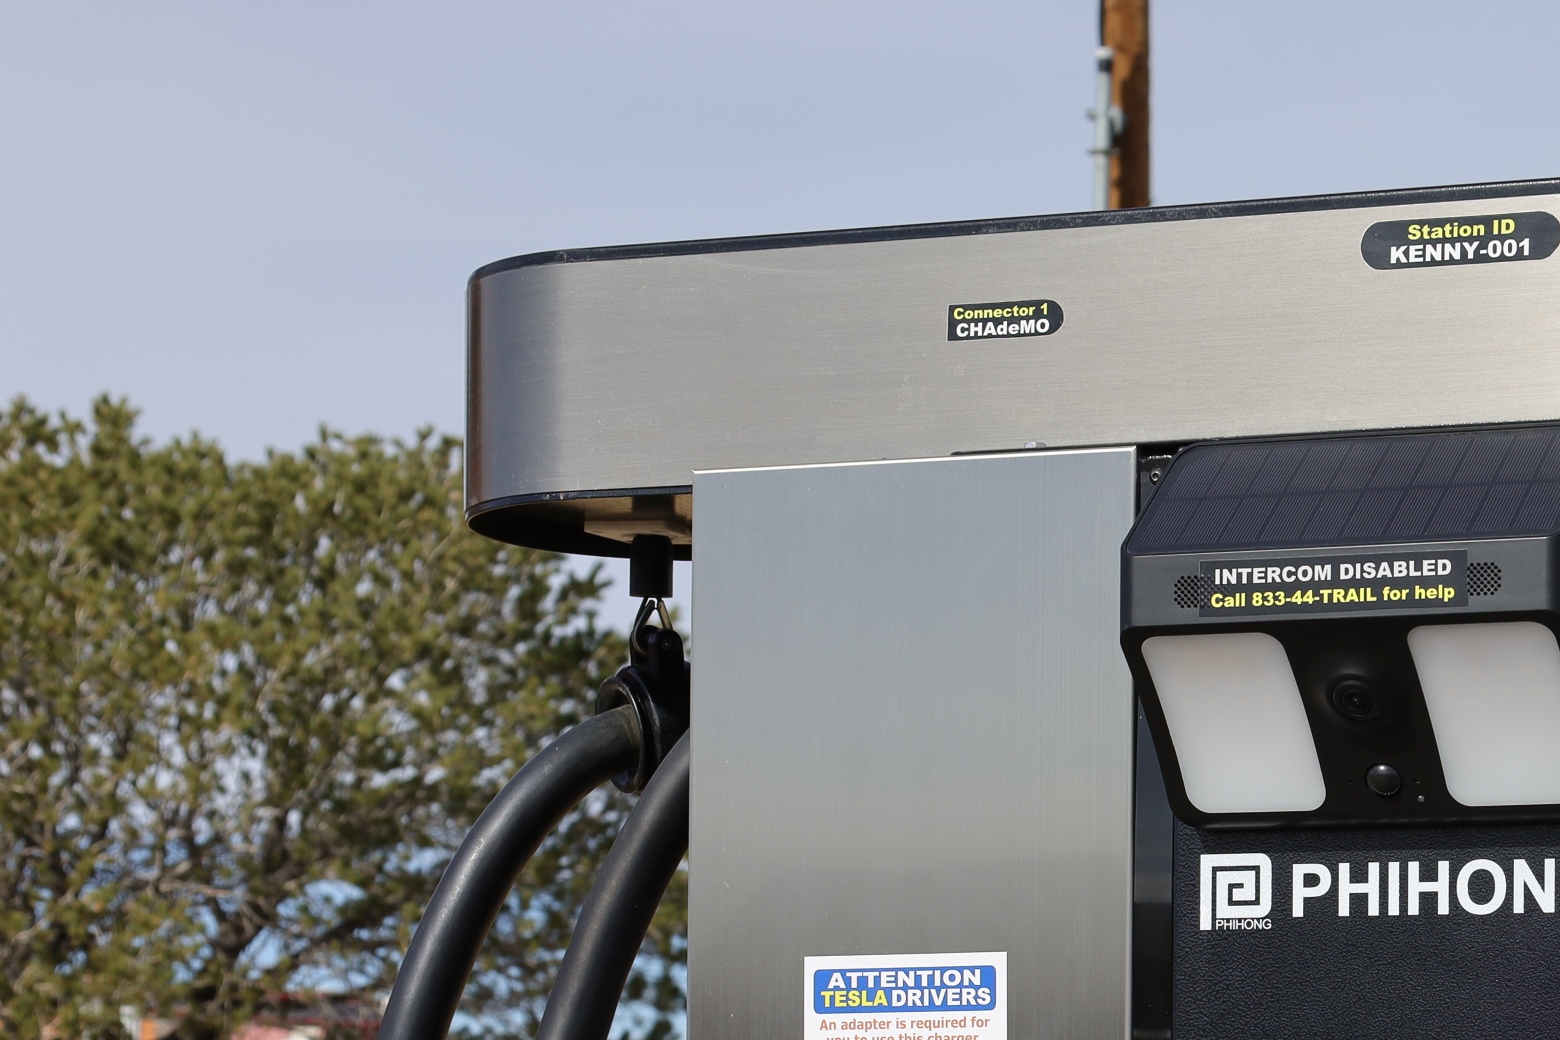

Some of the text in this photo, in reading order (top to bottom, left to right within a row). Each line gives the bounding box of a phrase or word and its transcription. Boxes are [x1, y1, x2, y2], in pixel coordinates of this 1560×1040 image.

[1408, 219, 1515, 240] Station ID
[1390, 238, 1530, 264] KENNY-001
[954, 302, 1048, 320] Connector 1
[956, 319, 1049, 337] CHAdeMO
[1214, 559, 1451, 585] INTERCOM DISABLED
[1211, 584, 1455, 607] Call 833-44-TRAIL for help
[1216, 918, 1272, 930] PHIHONG
[828, 969, 981, 989] ATTENTION
[821, 988, 991, 1007] TESLA DRIVERS
[820, 1016, 990, 1032] An adapter is required for
